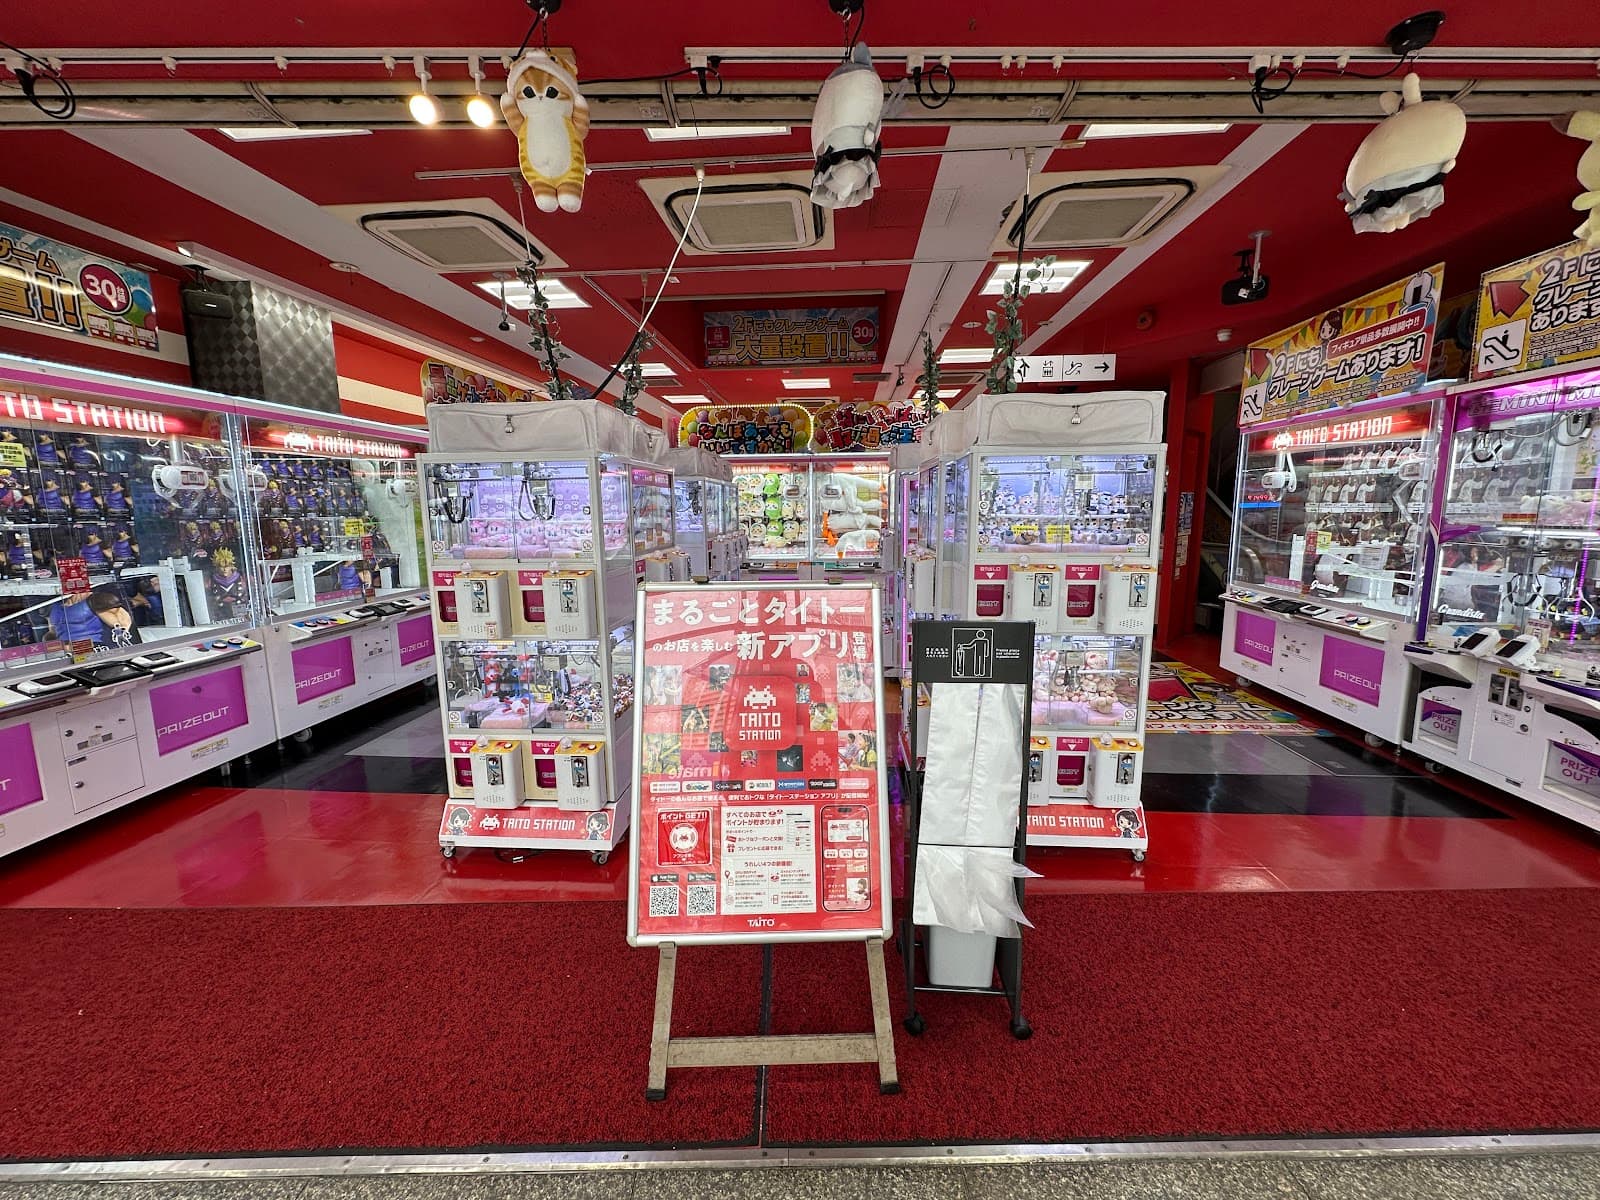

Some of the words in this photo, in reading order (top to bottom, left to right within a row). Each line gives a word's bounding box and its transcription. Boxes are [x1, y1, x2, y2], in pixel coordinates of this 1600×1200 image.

[733, 315, 850, 333] 2Fにもクレーンゲーム
[736, 332, 849, 361] 大量設置!!
[1268, 334, 1425, 400] クレーンゲームあります!
[1272, 346, 1321, 378] 2Fにも
[51, 397, 166, 433] STATION
[1295, 426, 1329, 444] TAITO
[1332, 415, 1393, 440] STATION
[317, 435, 354, 454] TAITO
[357, 440, 402, 458] STATION
[652, 597, 866, 626] まるごとタイトー
[1438, 604, 1487, 620] Grandista
[652, 638, 733, 652] のお店を楽しむ
[736, 629, 849, 660] 新アプリ
[852, 631, 868, 660] 登場
[739, 712, 781, 727] TAITO
[1431, 711, 1457, 727] PRIZE
[1433, 721, 1454, 734] OUT
[739, 731, 781, 741] STATION
[1560, 757, 1597, 777] PRIZE
[1561, 768, 1593, 784] OUT
[726, 811, 767, 819] すべてのお店で
[1027, 815, 1056, 827] TAITO
[1058, 816, 1105, 829] STATION
[502, 817, 530, 829] TAITO
[533, 818, 576, 831] STATION
[747, 917, 776, 927] TAITO
